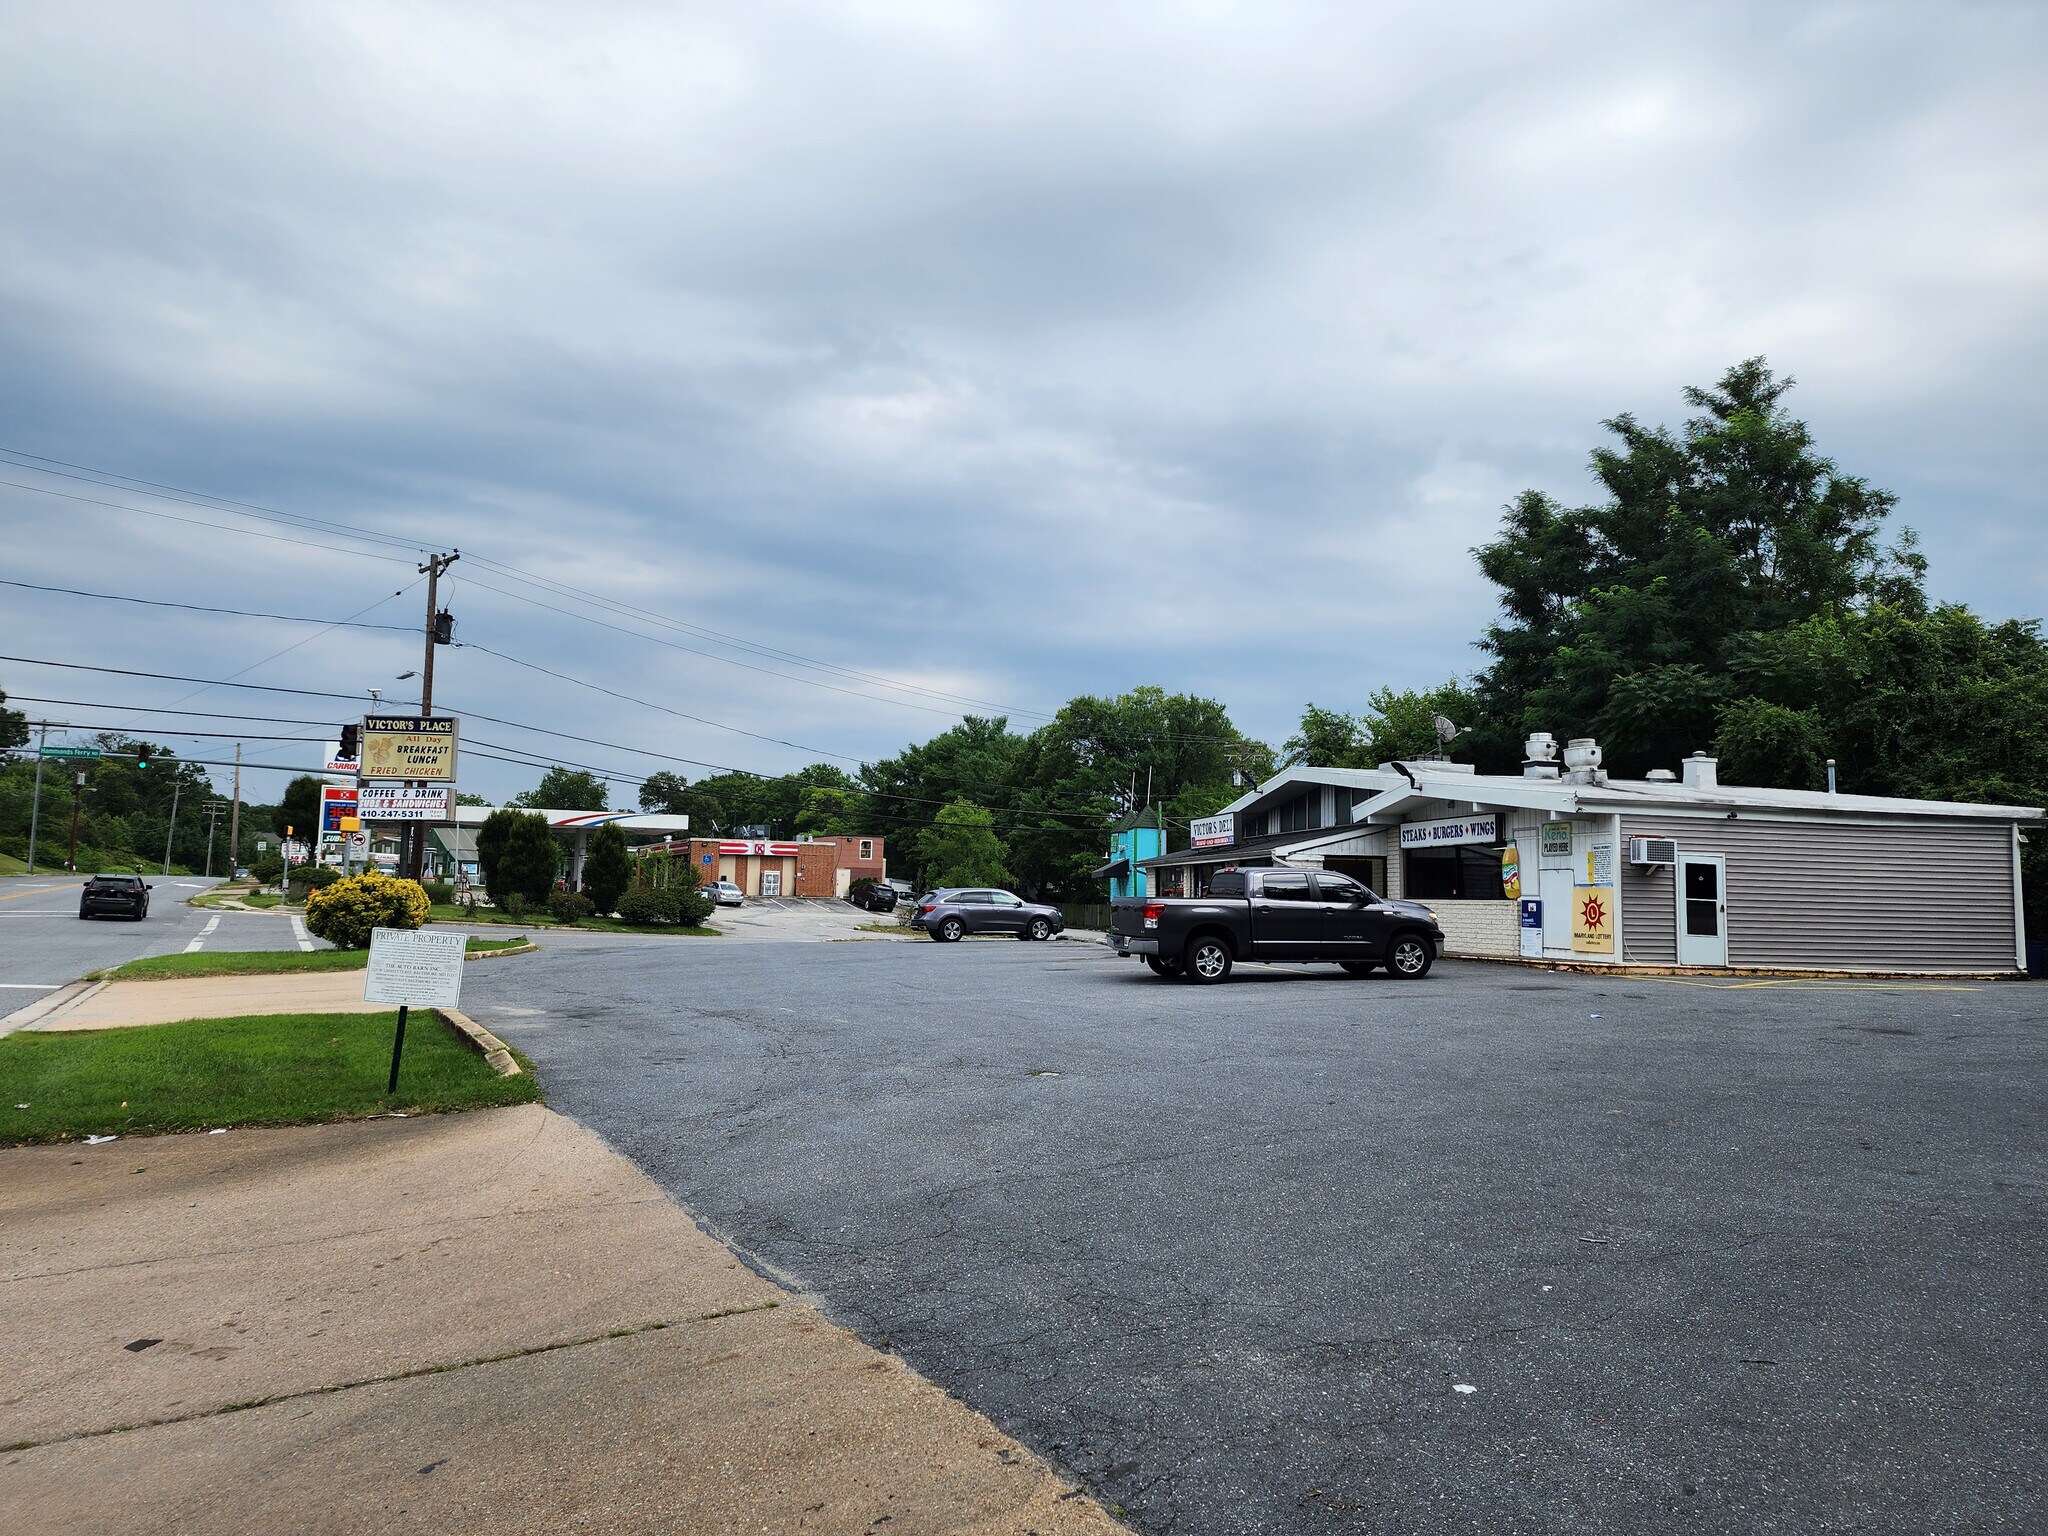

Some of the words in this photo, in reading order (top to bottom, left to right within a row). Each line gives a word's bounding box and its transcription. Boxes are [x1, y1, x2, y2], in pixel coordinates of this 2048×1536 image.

[368, 720, 414, 730] VICTOR'S
[420, 721, 452, 731] PLACE
[397, 745, 449, 754] BREAKFAST
[407, 756, 438, 764] LUNCH
[370, 766, 397, 774] FRIED
[404, 767, 443, 775] CHICKEN
[362, 789, 396, 798] COFFEE
[402, 790, 408, 798] &
[415, 789, 443, 798] DRINK
[359, 799, 381, 808] SUBS
[383, 799, 389, 808] &
[391, 799, 446, 808] SANDWICHES
[361, 810, 423, 818] 410-247-5311
[1193, 821, 1217, 836] VICTOR'S
[1219, 818, 1233, 833] DELI
[1402, 828, 1426, 842] STEAKS
[1432, 824, 1464, 840] BURGERS
[1470, 821, 1495, 836] WINGS
[1558, 842, 1568, 852] HERE
[375, 931, 410, 942] PRIVATE
[413, 934, 462, 945] PROPERTY
